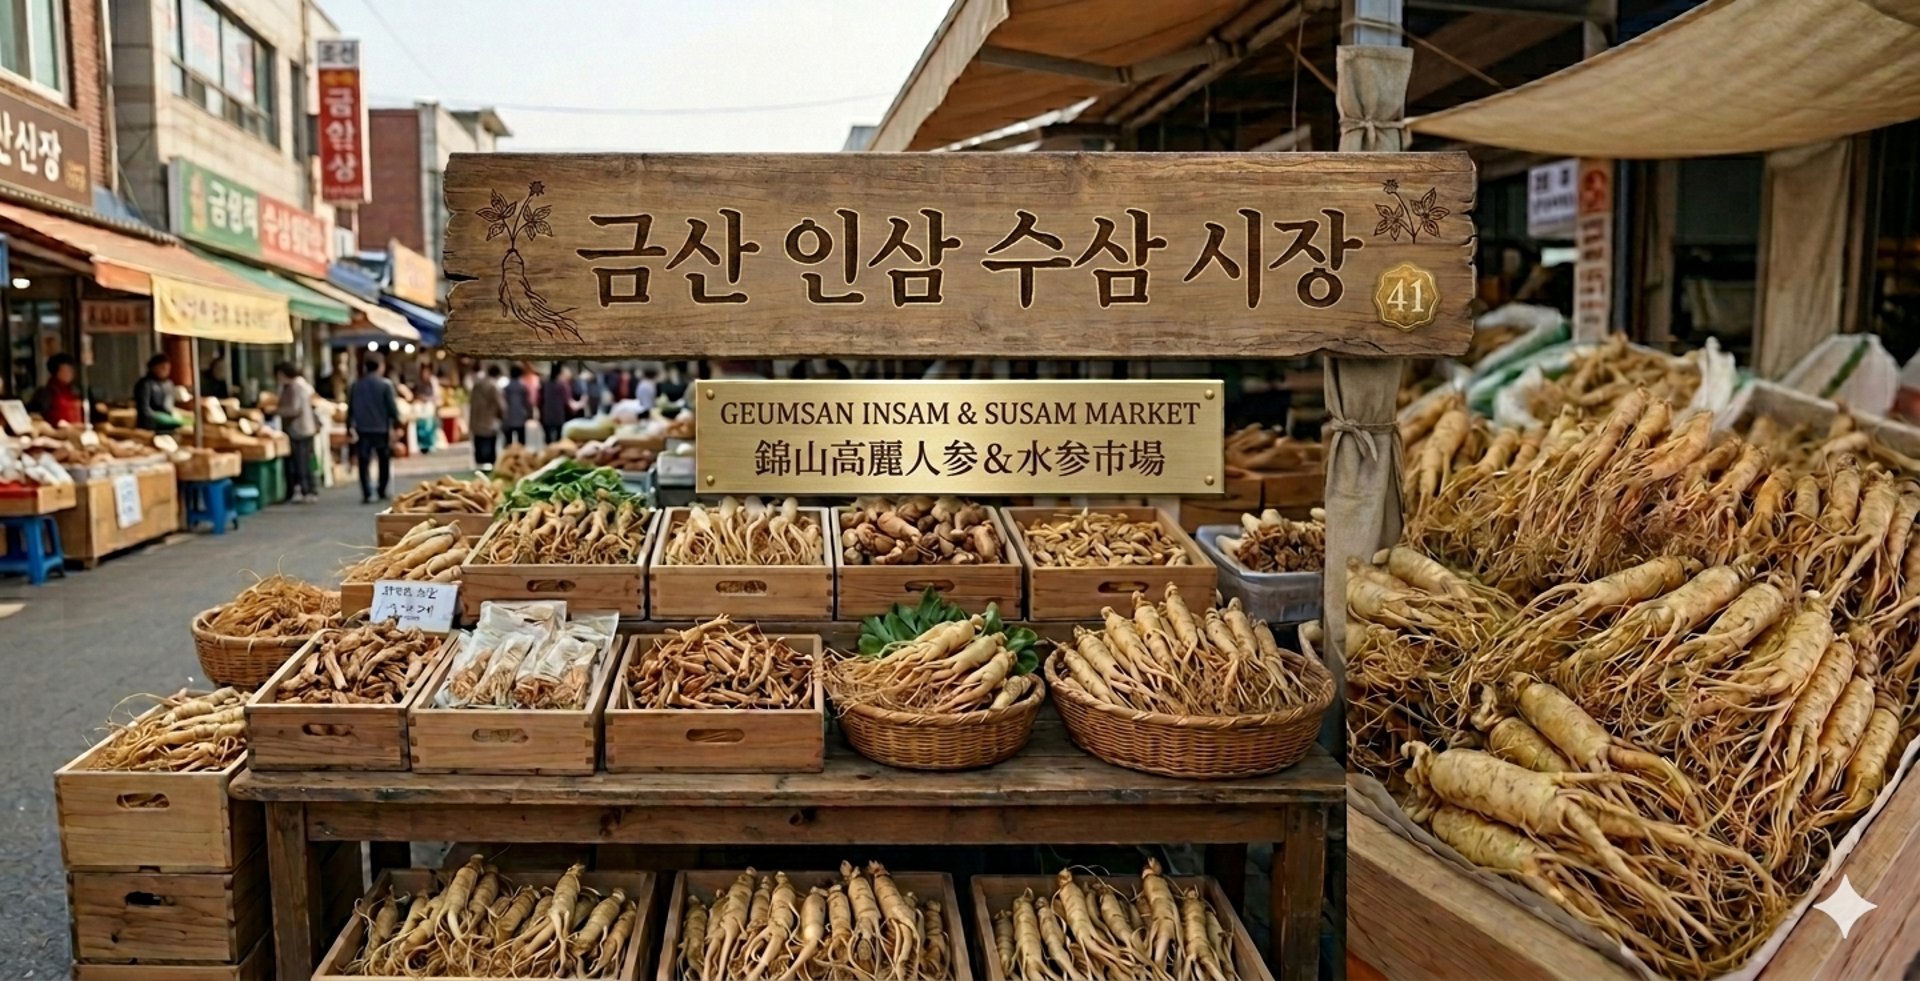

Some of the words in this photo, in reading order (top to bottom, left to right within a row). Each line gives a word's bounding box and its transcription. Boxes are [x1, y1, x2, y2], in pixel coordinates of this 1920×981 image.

[576, 207, 761, 308] 금산
[784, 207, 962, 308] 인삼
[980, 207, 1168, 309] 수삼
[1182, 207, 1364, 309] 시장
[1386, 278, 1425, 313] 41
[720, 401, 855, 426] GEUMSAN
[862, 401, 950, 425] INSAM
[957, 401, 979, 425] &
[984, 401, 1077, 425] SUSAM
[1084, 401, 1201, 425] MARKET
